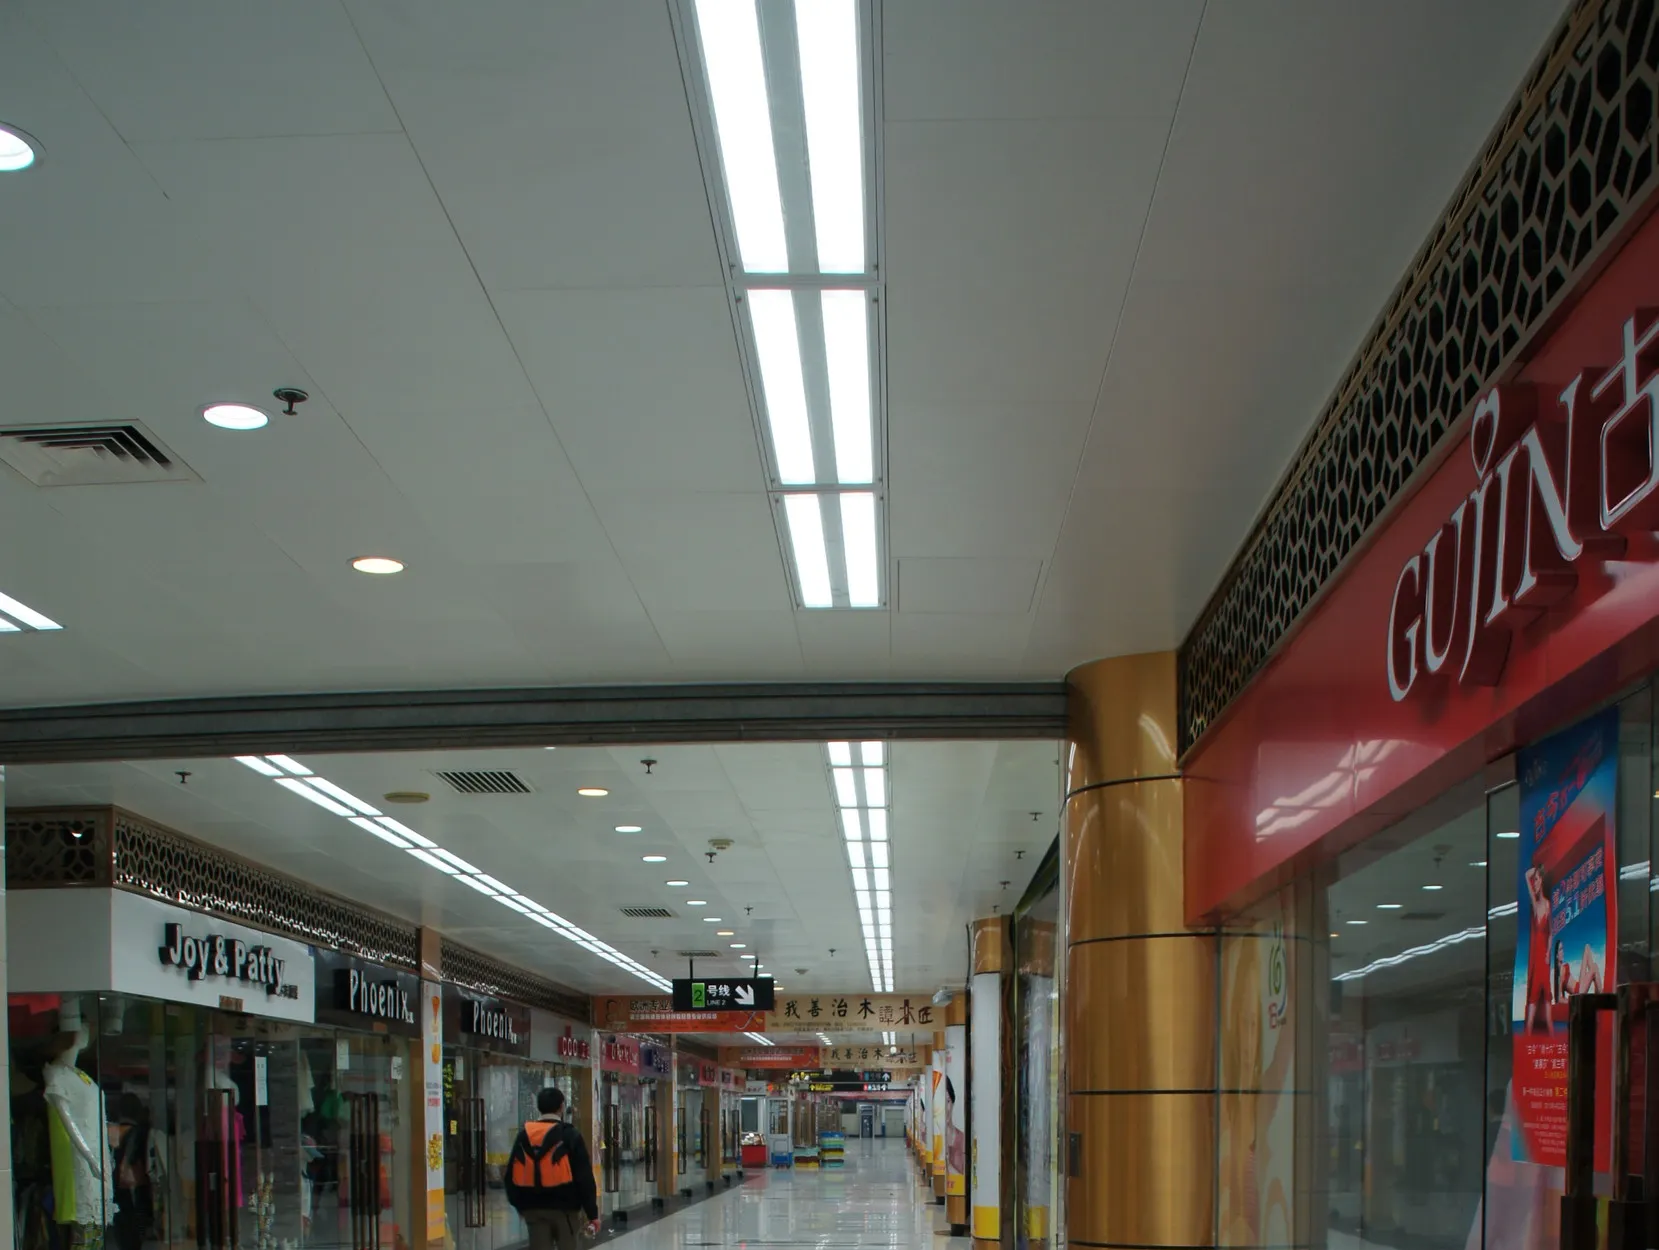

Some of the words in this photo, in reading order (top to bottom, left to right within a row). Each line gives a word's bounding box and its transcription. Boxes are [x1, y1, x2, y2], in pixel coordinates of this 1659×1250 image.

[165, 923, 210, 980] Joy
[213, 934, 230, 975] &
[233, 939, 285, 995] Patty
[350, 968, 409, 1020] Phoenix
[784, 998, 876, 1020] 我善治木
[472, 1000, 514, 1041] Phoenix
